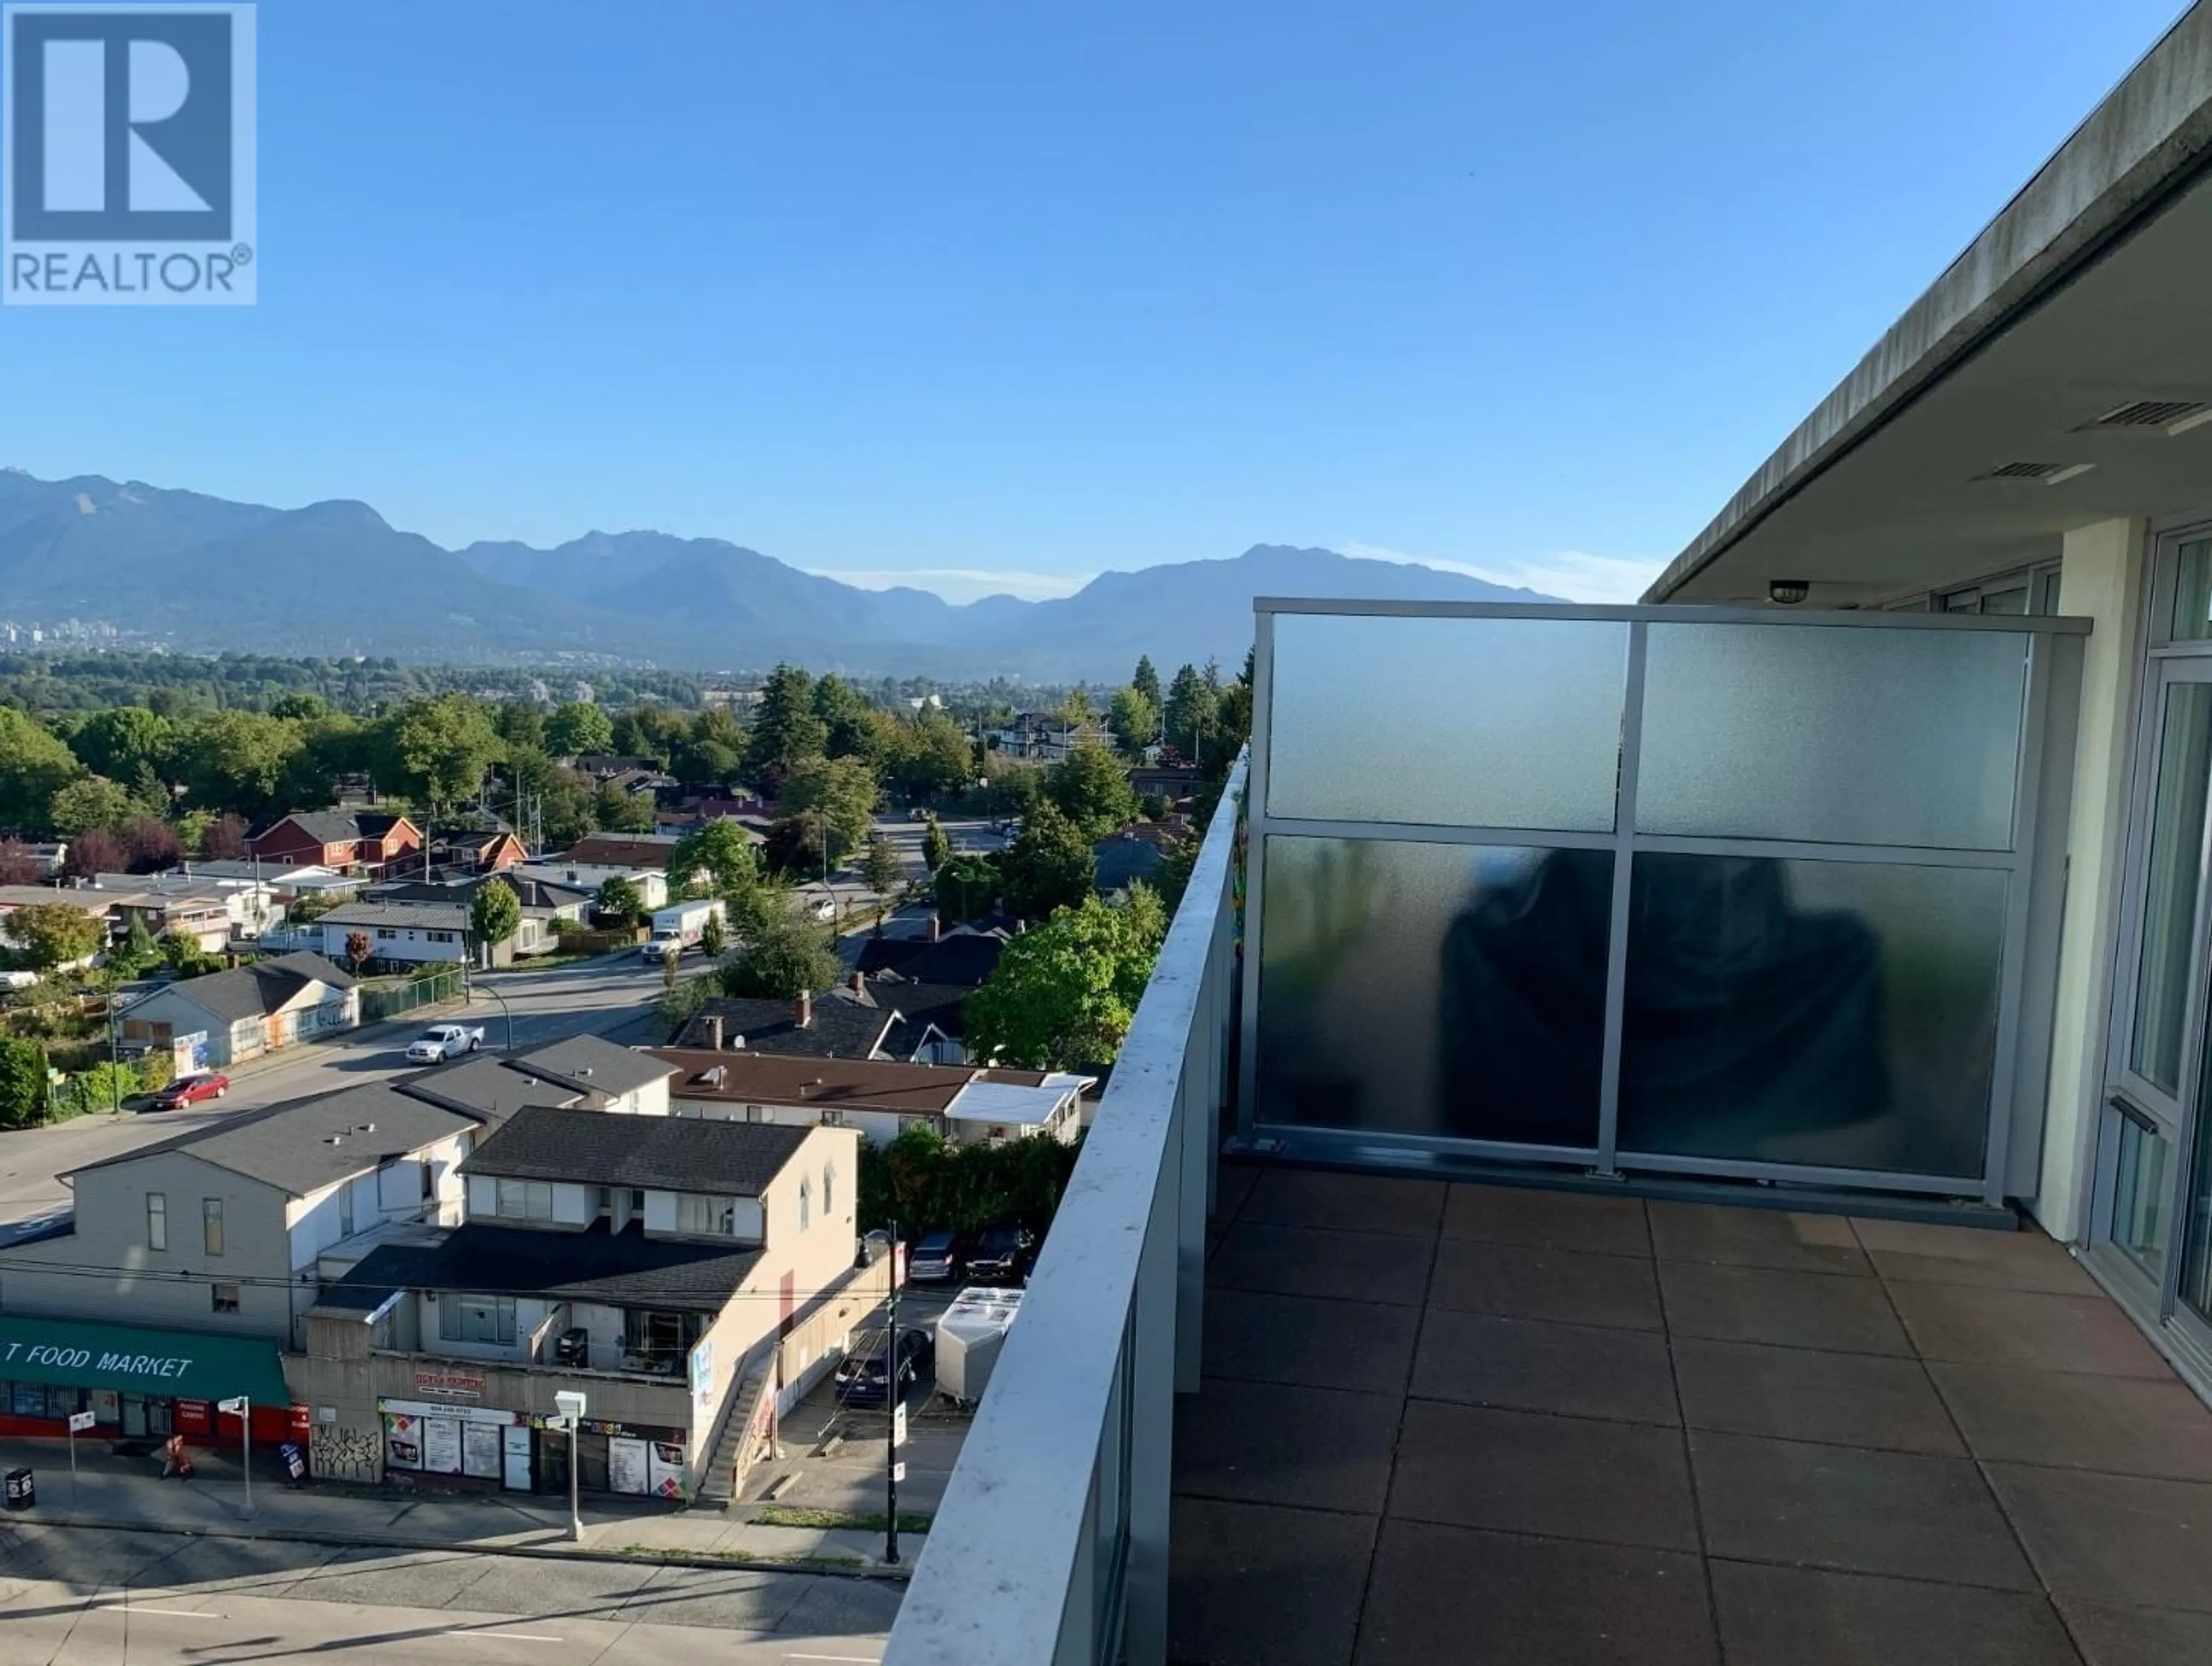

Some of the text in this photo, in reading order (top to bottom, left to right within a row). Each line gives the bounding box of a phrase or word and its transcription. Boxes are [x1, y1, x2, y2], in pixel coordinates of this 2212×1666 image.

[6, 1344, 193, 1378] T FOOD MARKET
